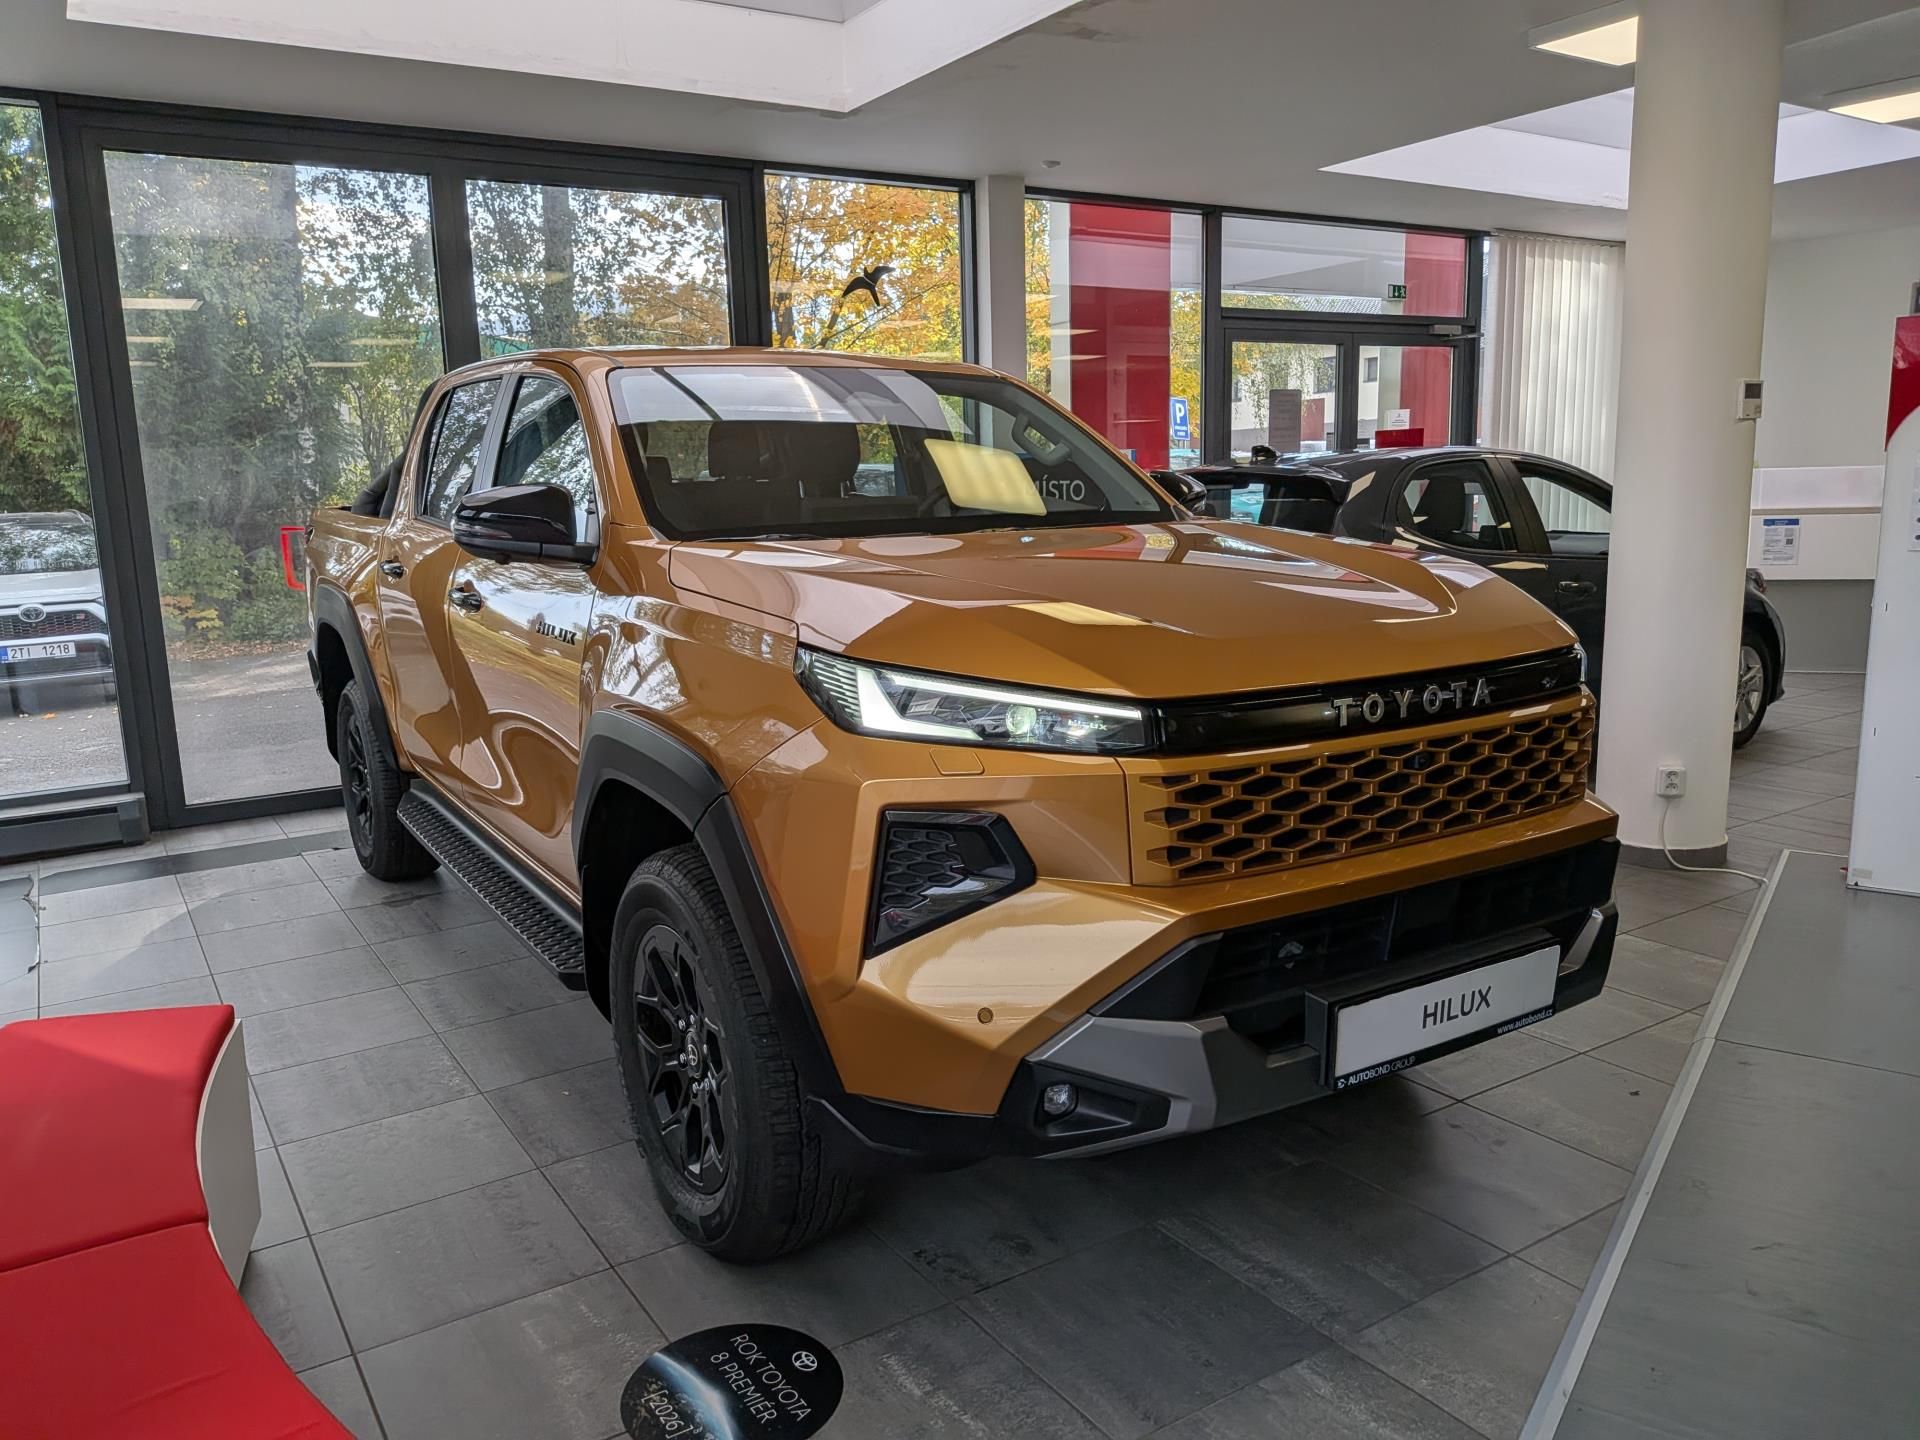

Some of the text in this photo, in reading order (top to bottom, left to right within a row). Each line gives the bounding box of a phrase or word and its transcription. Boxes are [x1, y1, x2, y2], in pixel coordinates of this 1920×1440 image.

[1175, 402, 1185, 424] P
[536, 620, 577, 646] HILUX
[42, 643, 70, 656] 1218
[1333, 676, 1492, 728] TOYOTA
[1422, 985, 1492, 1029] HILUX
[1497, 1008, 1553, 1035] www.autobond.cz
[1347, 1055, 1416, 1086] AUTOBOND GROUP
[710, 1352, 777, 1424] 8 PREMIÉR
[730, 1333, 812, 1422] ROK TOYOTA
